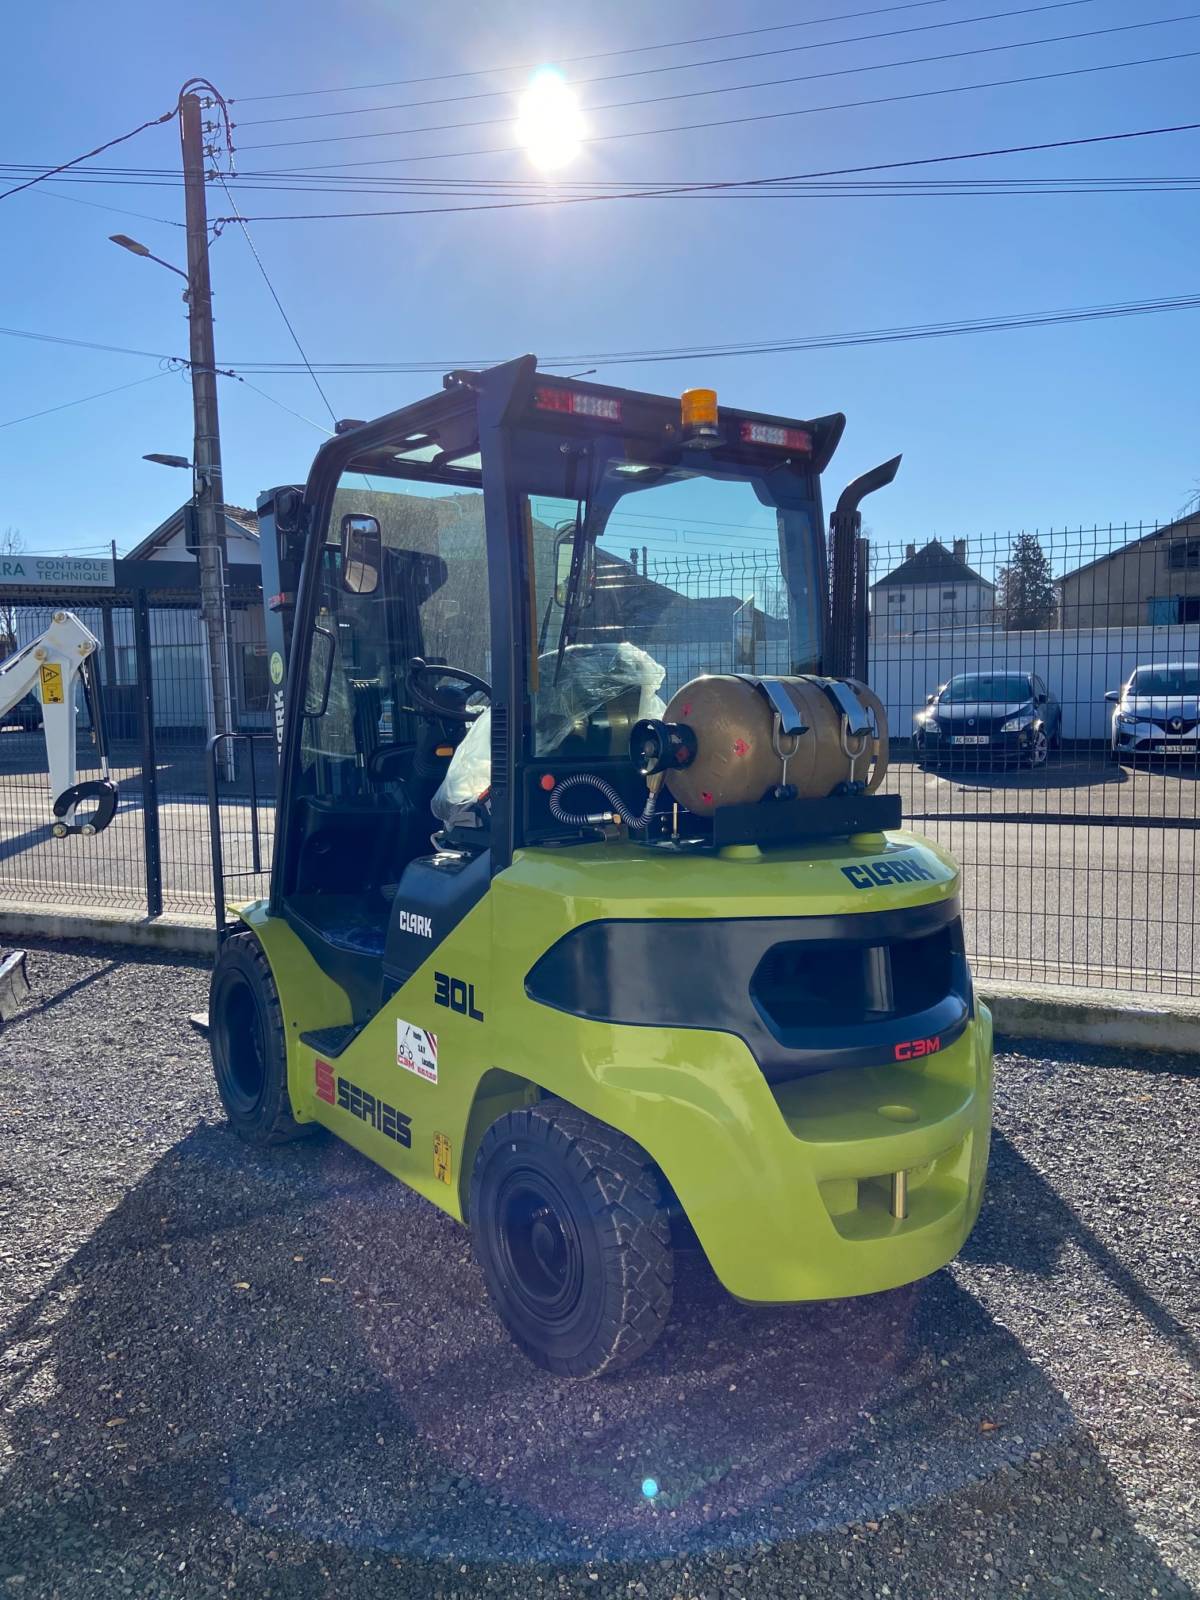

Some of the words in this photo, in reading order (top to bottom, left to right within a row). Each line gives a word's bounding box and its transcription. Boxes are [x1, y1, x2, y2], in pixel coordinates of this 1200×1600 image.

[0, 562, 26, 576] RA
[36, 560, 108, 571] CONTRÔLE
[36, 571, 109, 581] TECHNIQUE
[840, 859, 936, 889] CLARK
[399, 910, 432, 938] CLARK
[434, 971, 484, 1022] 30L
[337, 1077, 412, 1149] SERIES
